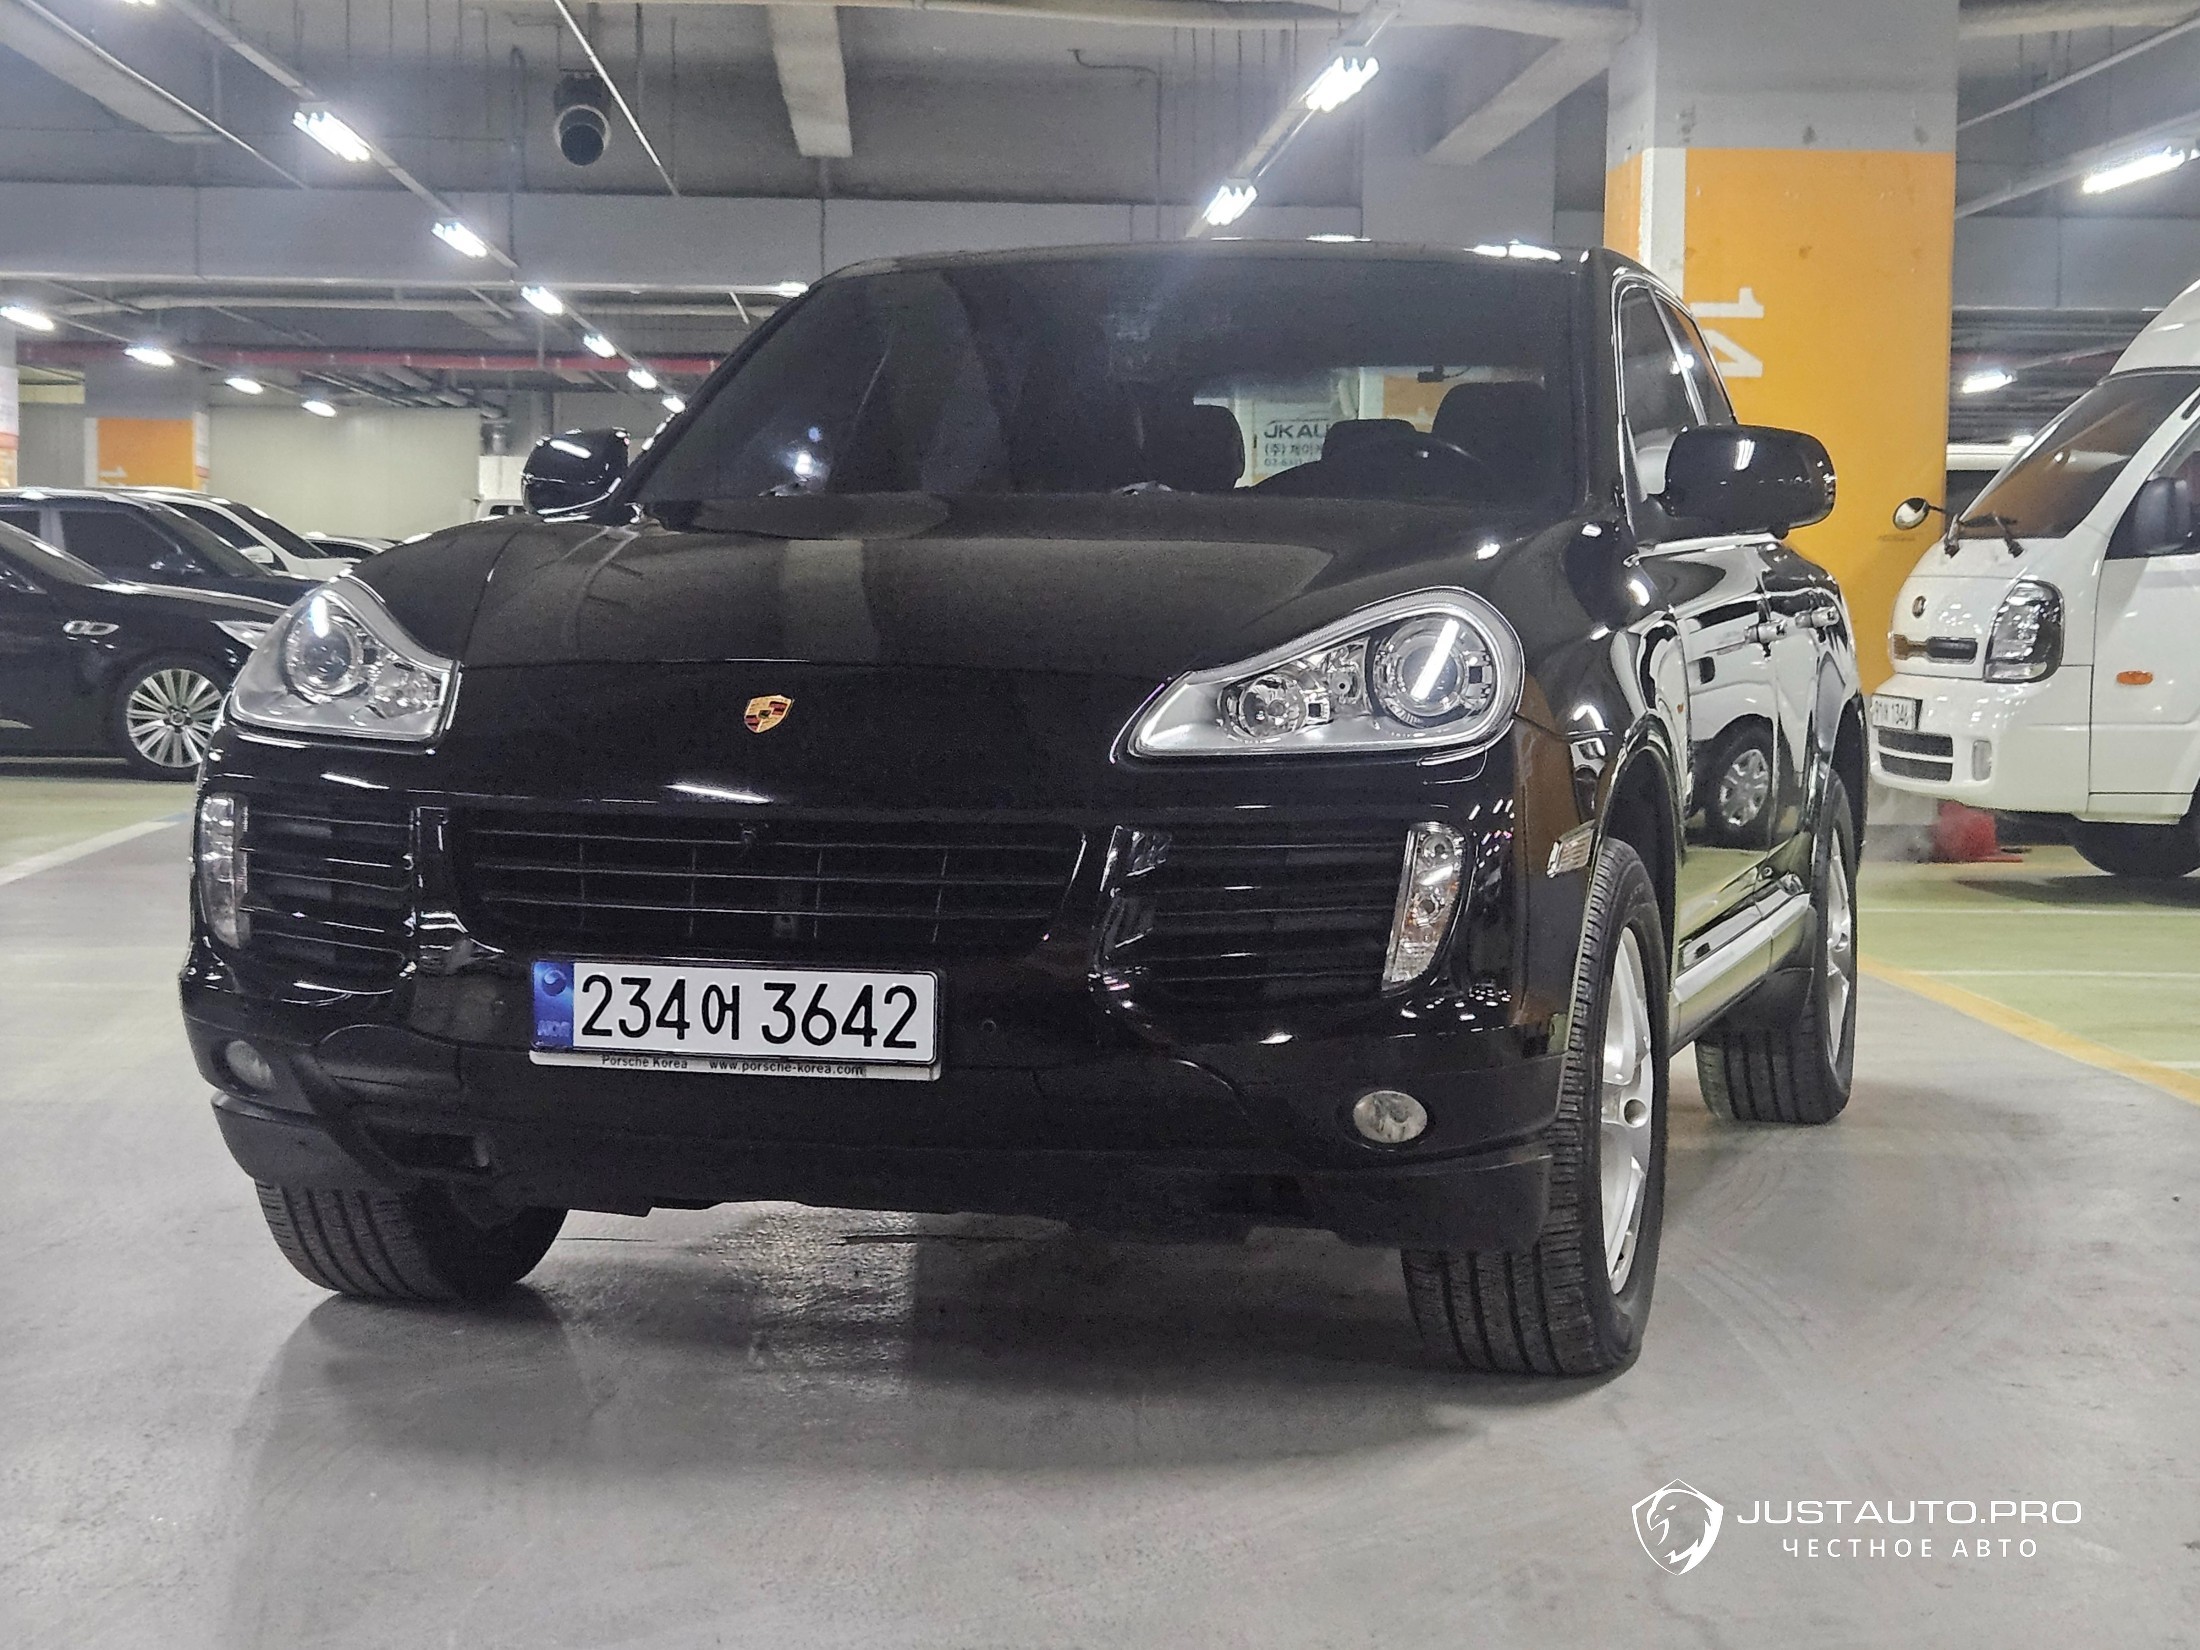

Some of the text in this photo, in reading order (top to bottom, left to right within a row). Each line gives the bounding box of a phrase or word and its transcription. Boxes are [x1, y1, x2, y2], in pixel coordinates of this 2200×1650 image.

[1690, 286, 1764, 378] 14
[581, 974, 918, 1049] 234어 3642
[601, 1054, 866, 1076] Porsche Korea www.porsche-korea.com
